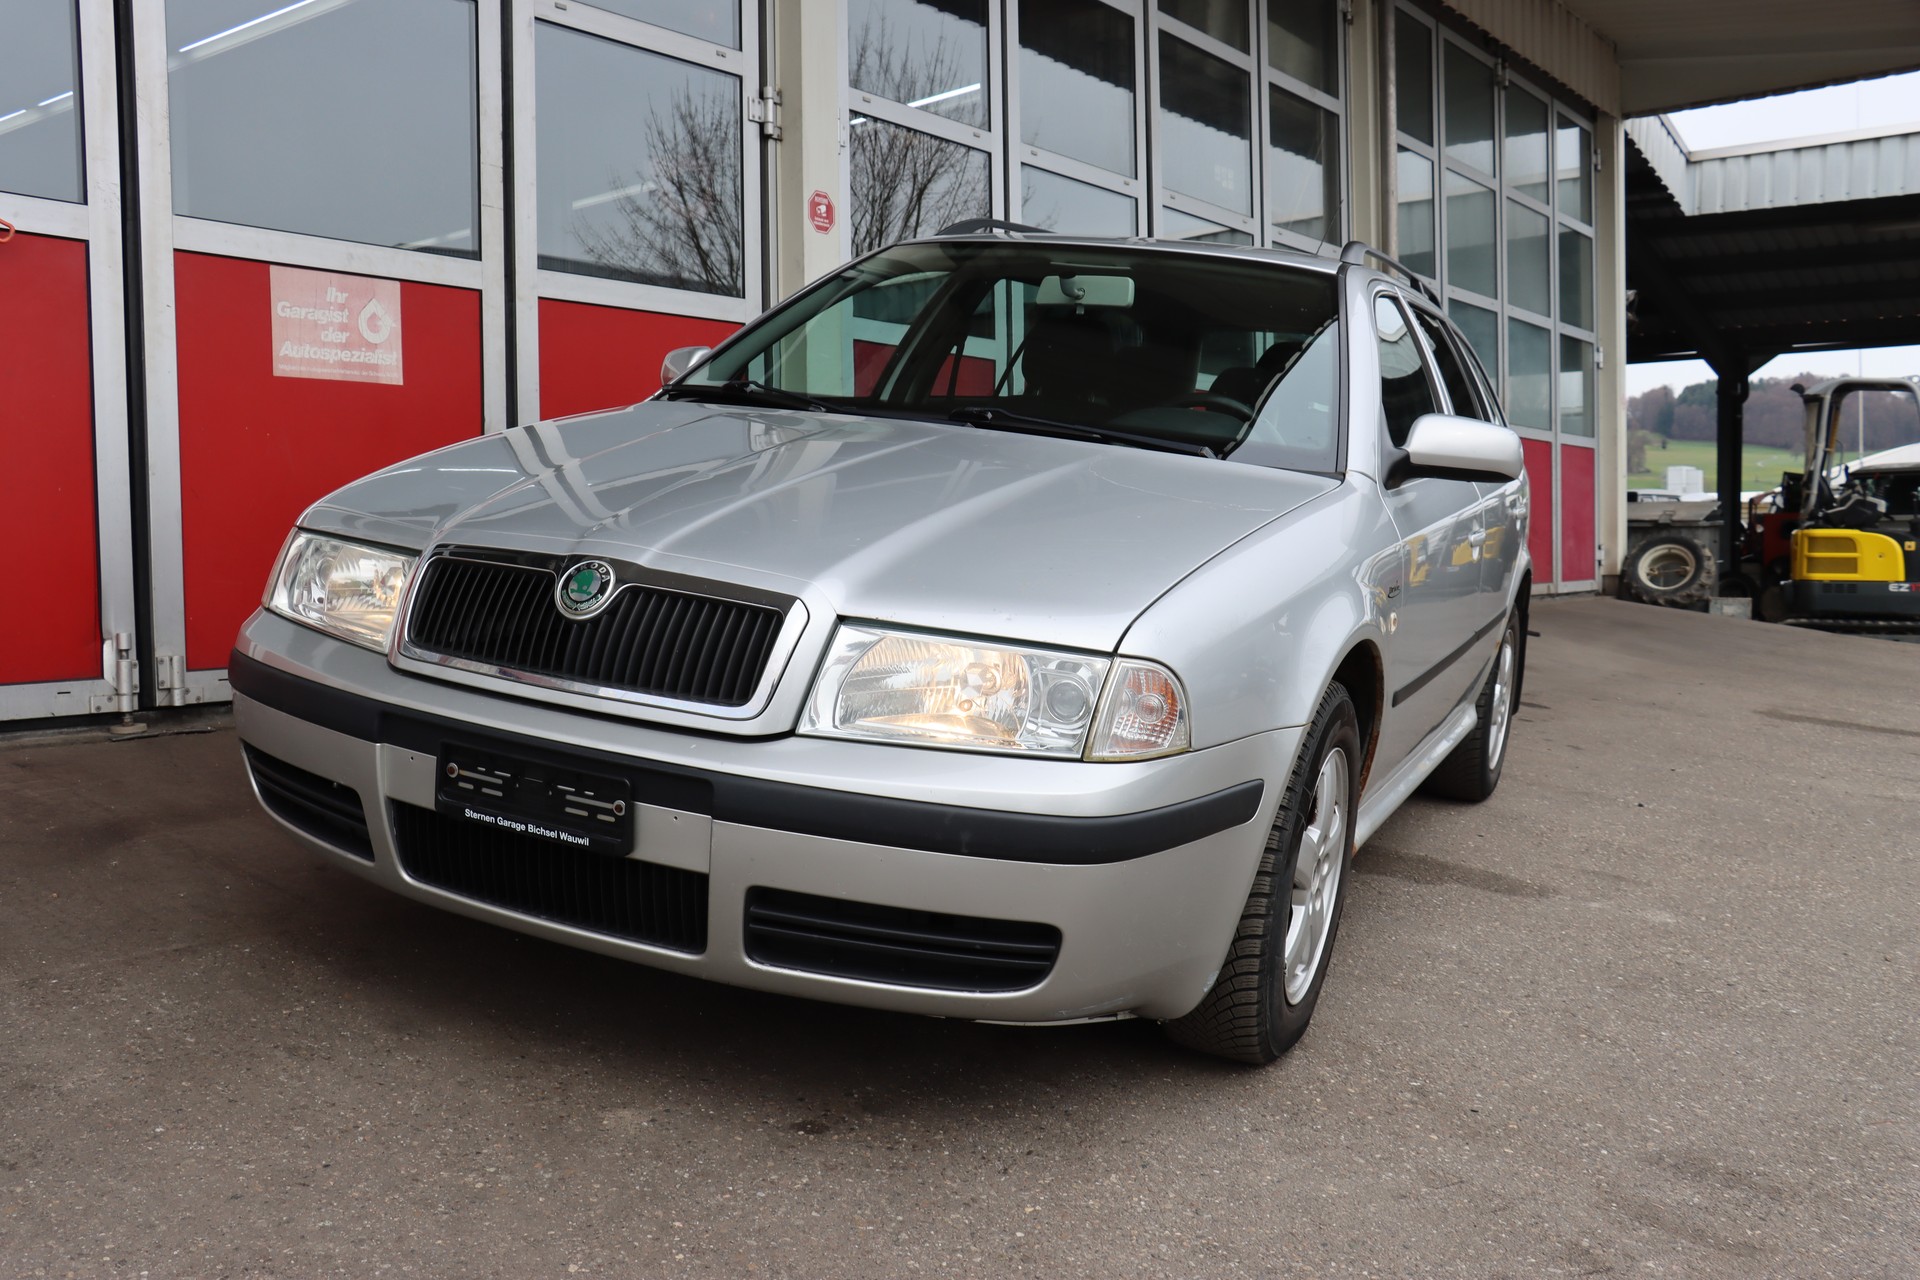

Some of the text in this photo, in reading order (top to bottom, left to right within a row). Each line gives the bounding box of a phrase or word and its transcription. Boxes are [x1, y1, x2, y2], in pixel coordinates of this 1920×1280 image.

[326, 286, 349, 304] Ihr
[276, 300, 350, 324] Garagist
[320, 326, 350, 343] der
[279, 340, 398, 366] Autospezialist
[464, 808, 590, 847] Sternen Garage Bichsel Wauwil
